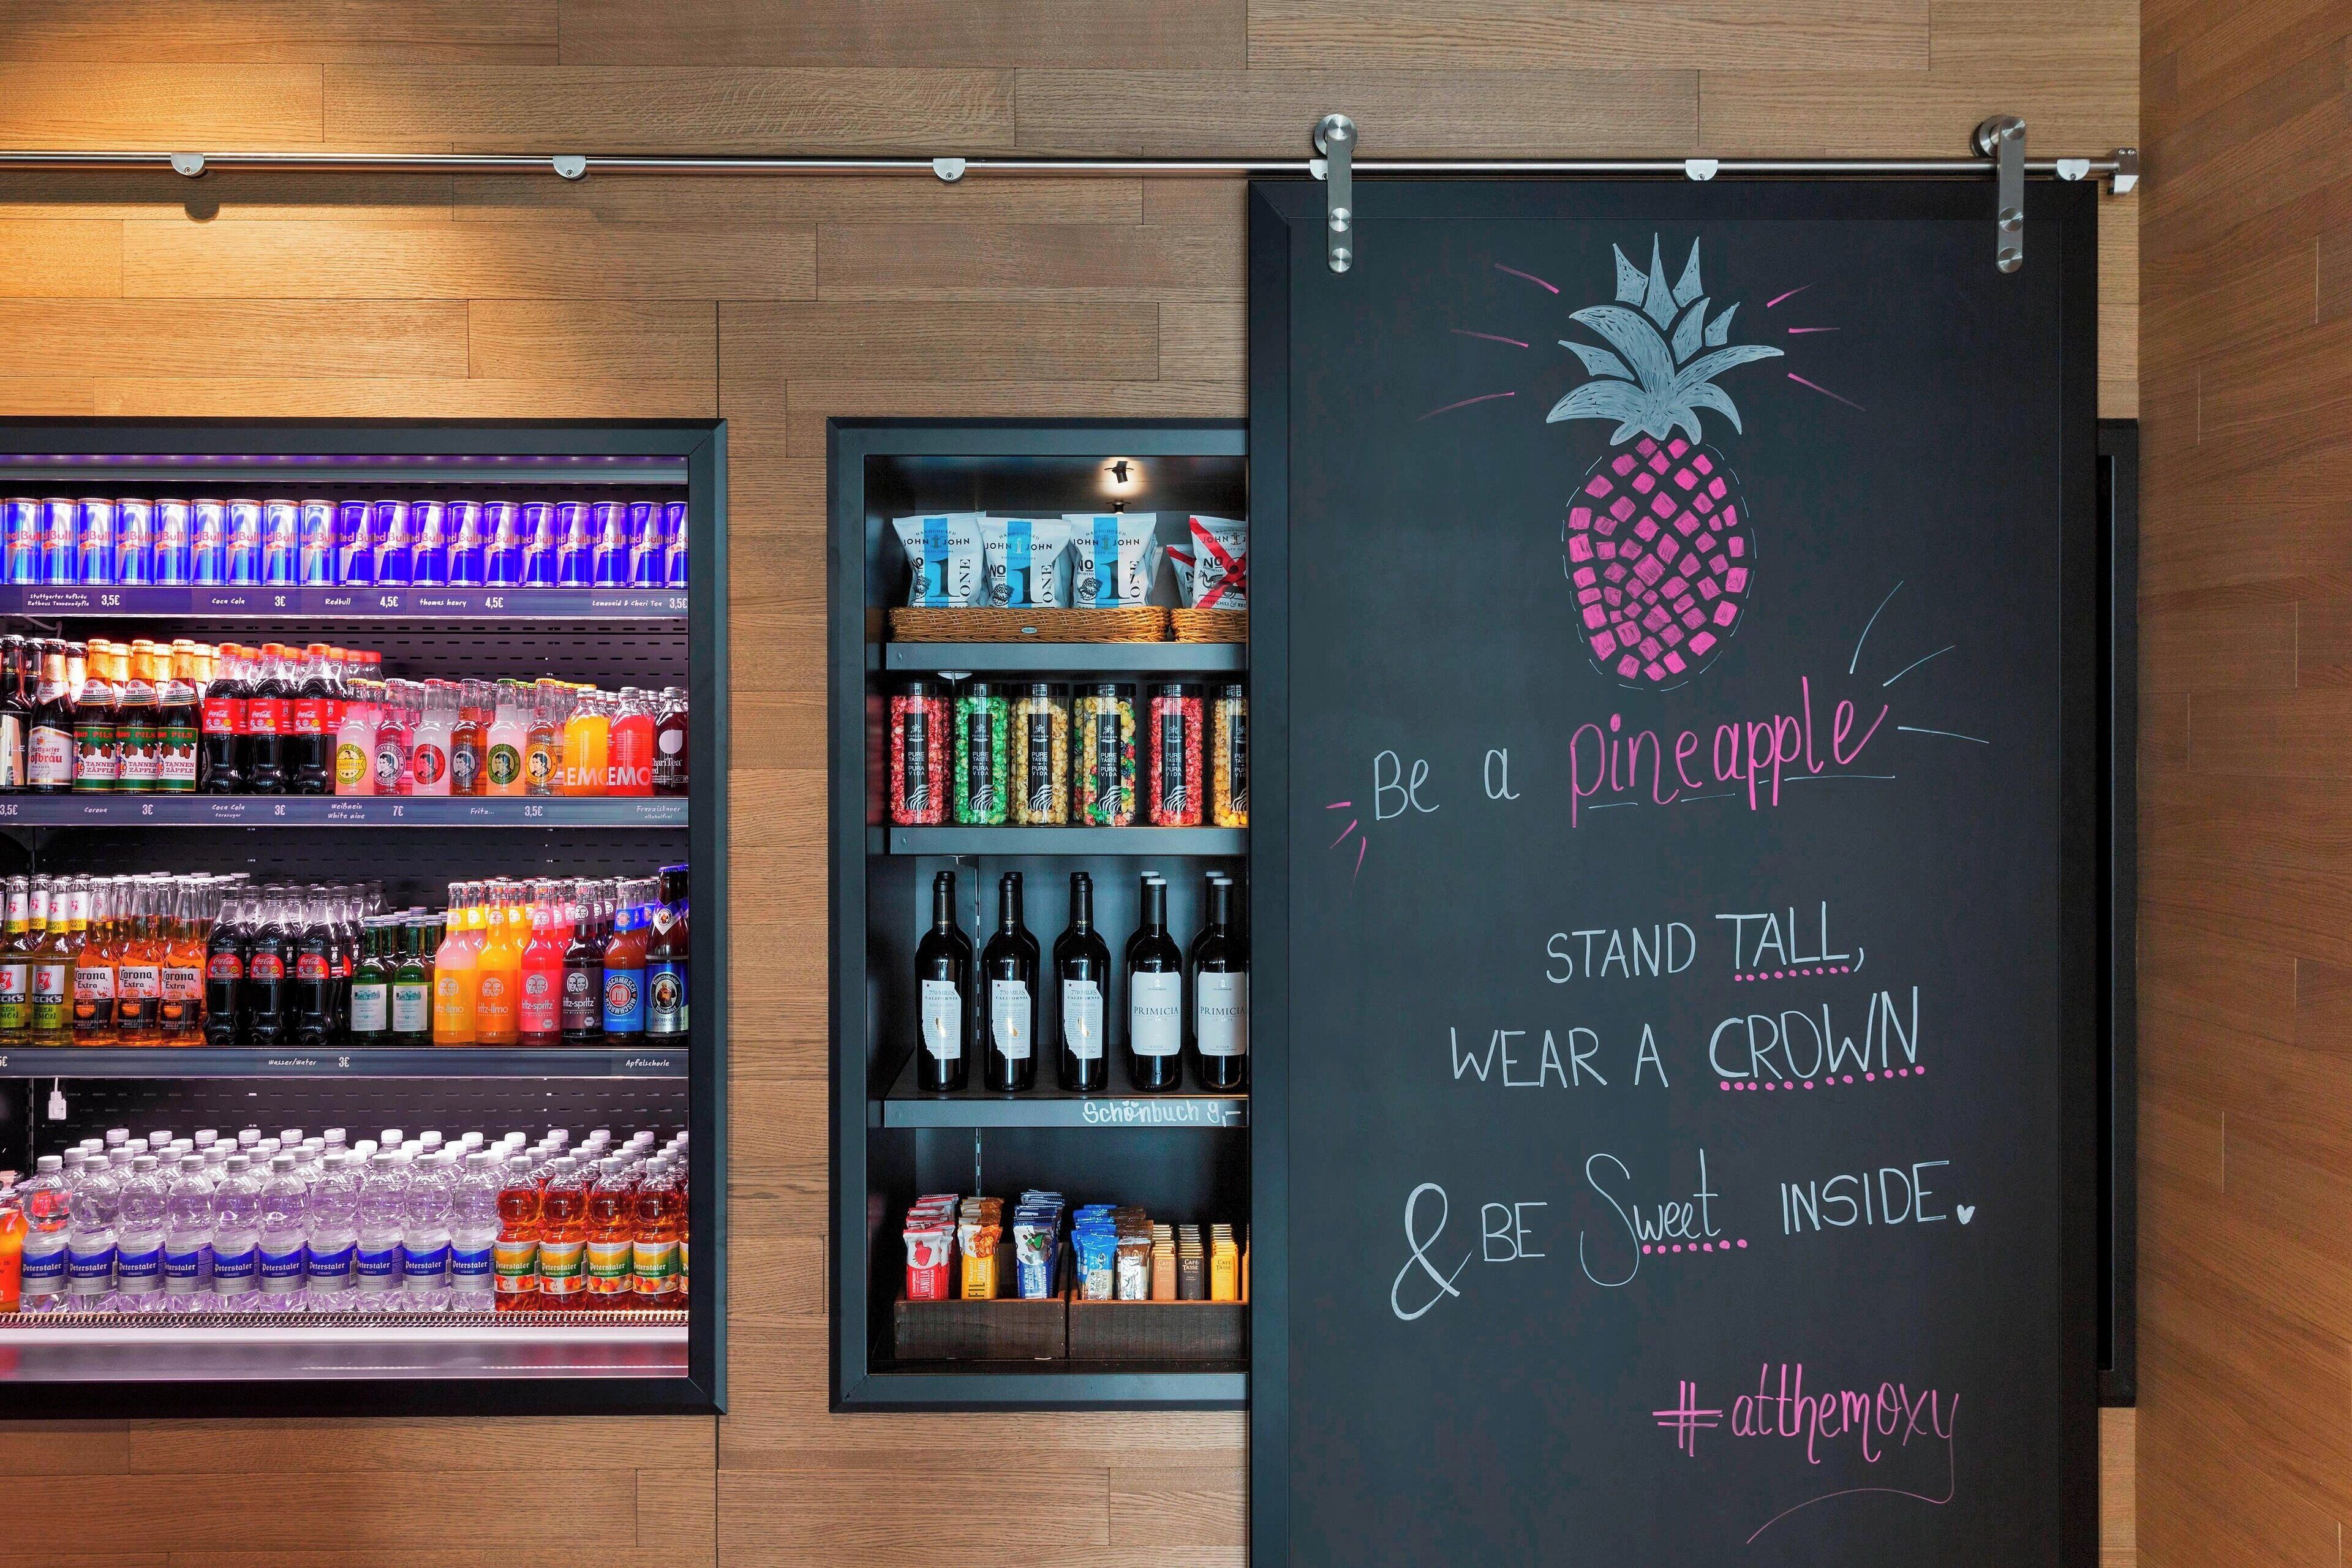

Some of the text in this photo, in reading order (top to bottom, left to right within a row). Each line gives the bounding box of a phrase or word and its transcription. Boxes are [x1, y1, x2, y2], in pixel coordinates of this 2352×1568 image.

[959, 559, 971, 597] ONE
[1042, 564, 1054, 603] ONE
[101, 594, 120, 606] 3,5€
[274, 596, 286, 607] 3€
[380, 596, 398, 608] 4,5€
[447, 598, 467, 608] henry
[485, 597, 504, 609] 4,5€
[669, 597, 687, 609] 3,5€
[1374, 676, 1888, 827] Be a pineapple
[142, 805, 153, 815] 3€
[275, 805, 285, 815] 3€
[393, 805, 404, 816] 7€
[524, 806, 543, 817] 3,5€
[1546, 901, 1867, 983] STAND TALL,
[75, 970, 106, 980] Corona
[119, 969, 153, 980] Corona
[163, 971, 194, 981] Corona
[1134, 1006, 1178, 1015] PRIMICIA
[1200, 1006, 1245, 1015] PRIMICIA
[1450, 986, 1919, 1088] WEAR A CROWN
[339, 1057, 350, 1068] 3€
[625, 1059, 669, 1068] Apfelschorle
[1083, 1101, 1199, 1123] Schönbuch
[1391, 1182, 1473, 1321] &
[1481, 1201, 1548, 1262] BE
[1580, 1148, 1722, 1287] Sweet
[23, 1263, 62, 1272] Peterstaler
[70, 1263, 107, 1272] Peterstaler
[119, 1262, 157, 1271] Peterstaler
[215, 1262, 253, 1272] Peterstaler
[262, 1262, 300, 1272] Peterstaler
[309, 1261, 345, 1270] Peterstaler
[405, 1261, 442, 1270] Peterstaler
[453, 1261, 488, 1269] Peterstaler
[1652, 1363, 1959, 1504] #atthemoxy
